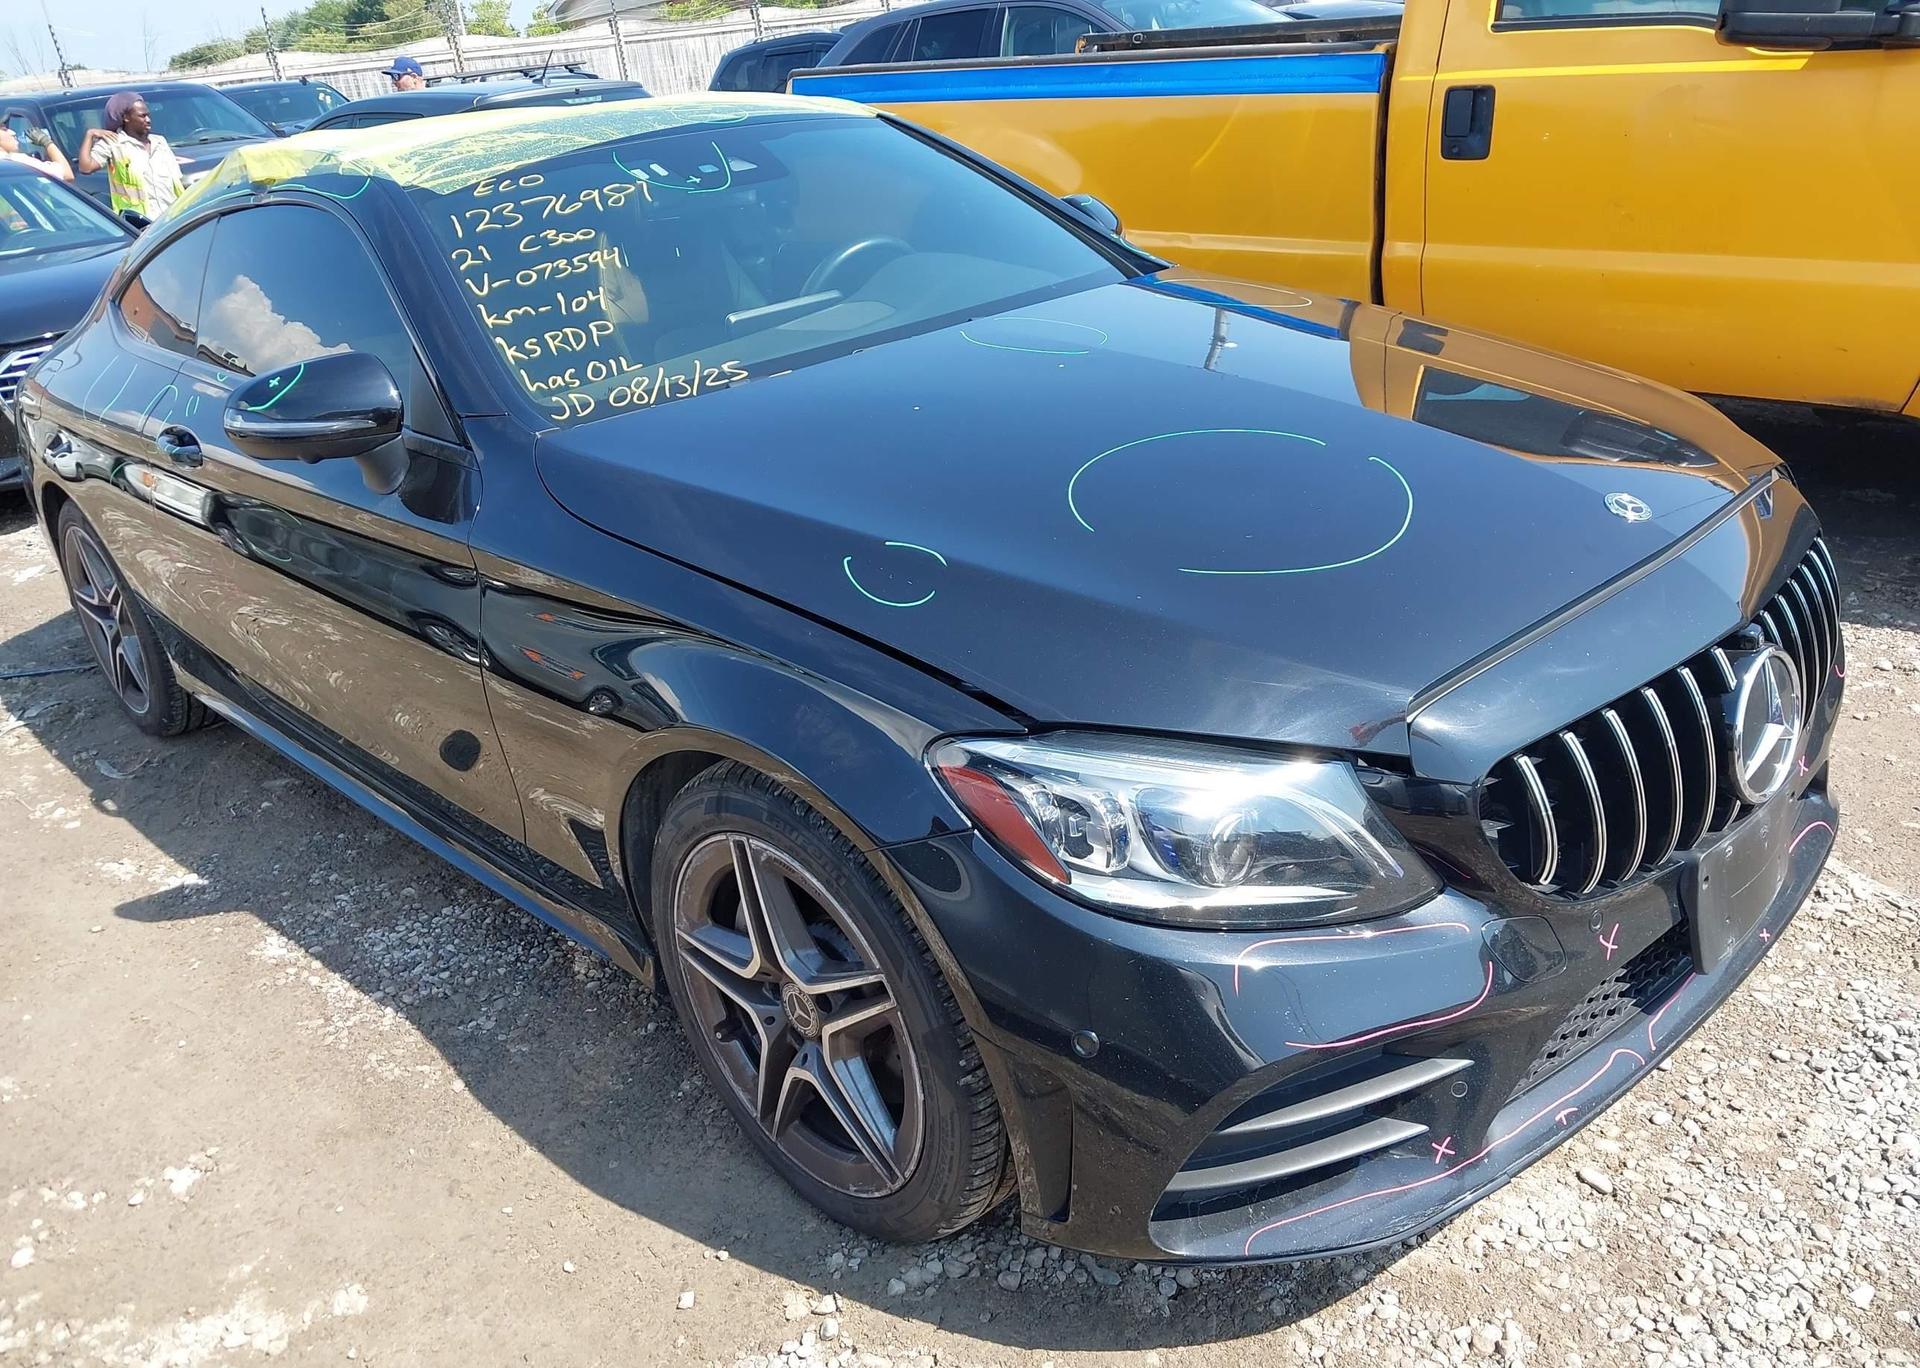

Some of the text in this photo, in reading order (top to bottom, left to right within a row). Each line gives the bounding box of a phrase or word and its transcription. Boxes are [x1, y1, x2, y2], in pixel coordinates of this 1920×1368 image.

[451, 228, 596, 271] 21 C300
[477, 286, 609, 329] km-104
[550, 360, 750, 420] JD 08/13/25
